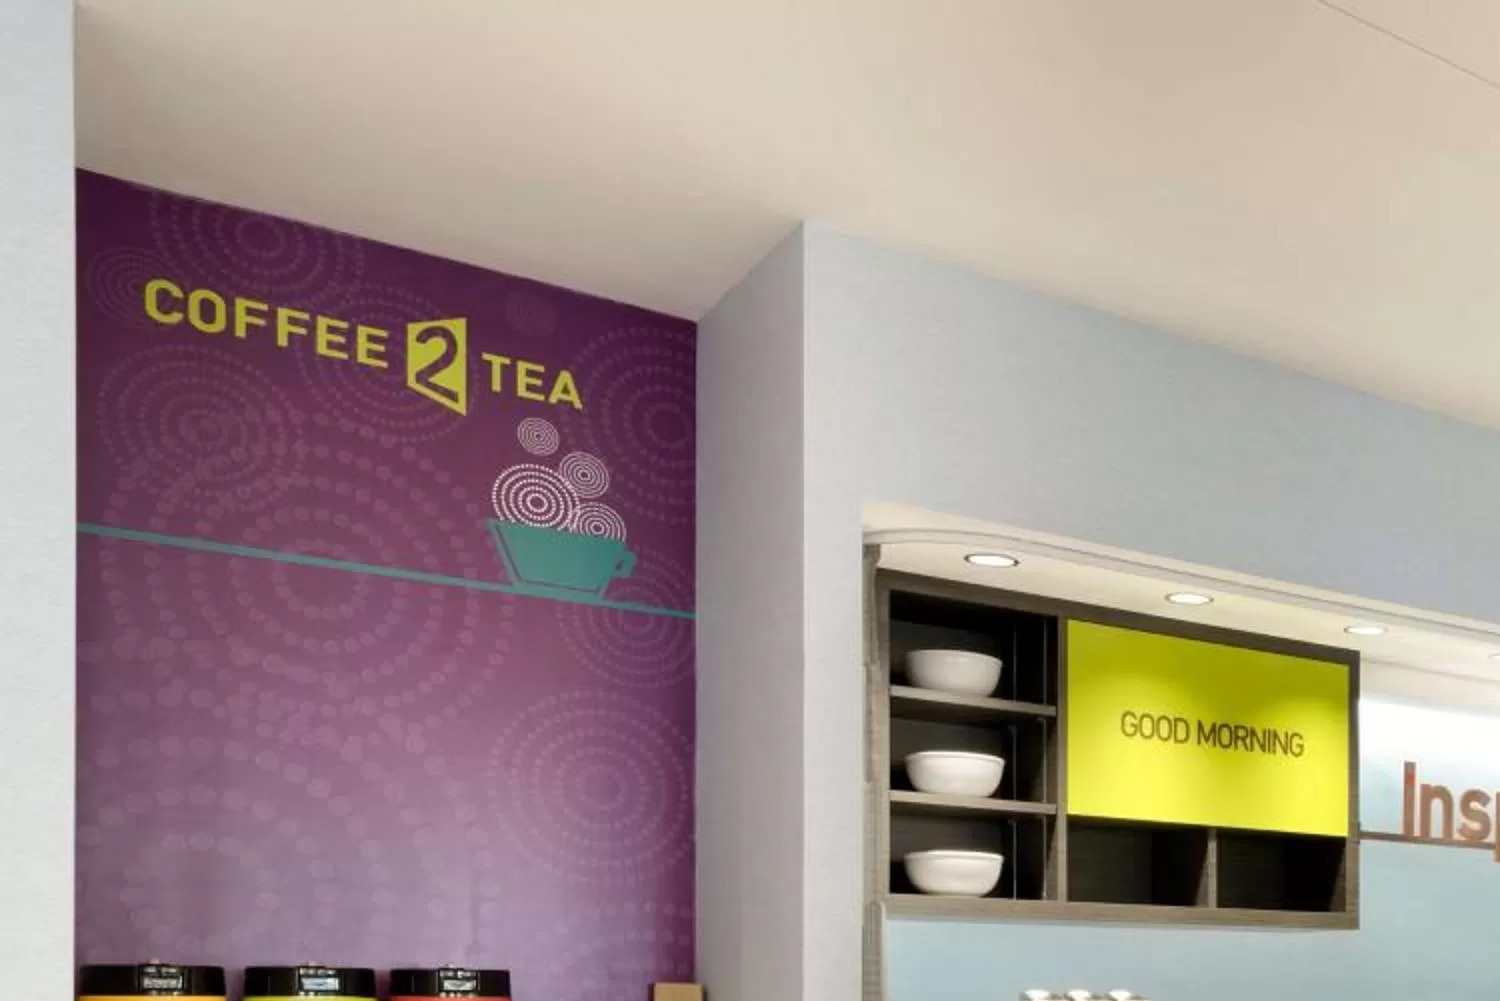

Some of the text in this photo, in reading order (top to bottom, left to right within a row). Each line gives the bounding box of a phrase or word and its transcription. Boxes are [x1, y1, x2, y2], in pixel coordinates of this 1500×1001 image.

[144, 279, 583, 410] COFFEE 2 TEA
[1121, 711, 1304, 757] GOOD MORNING
